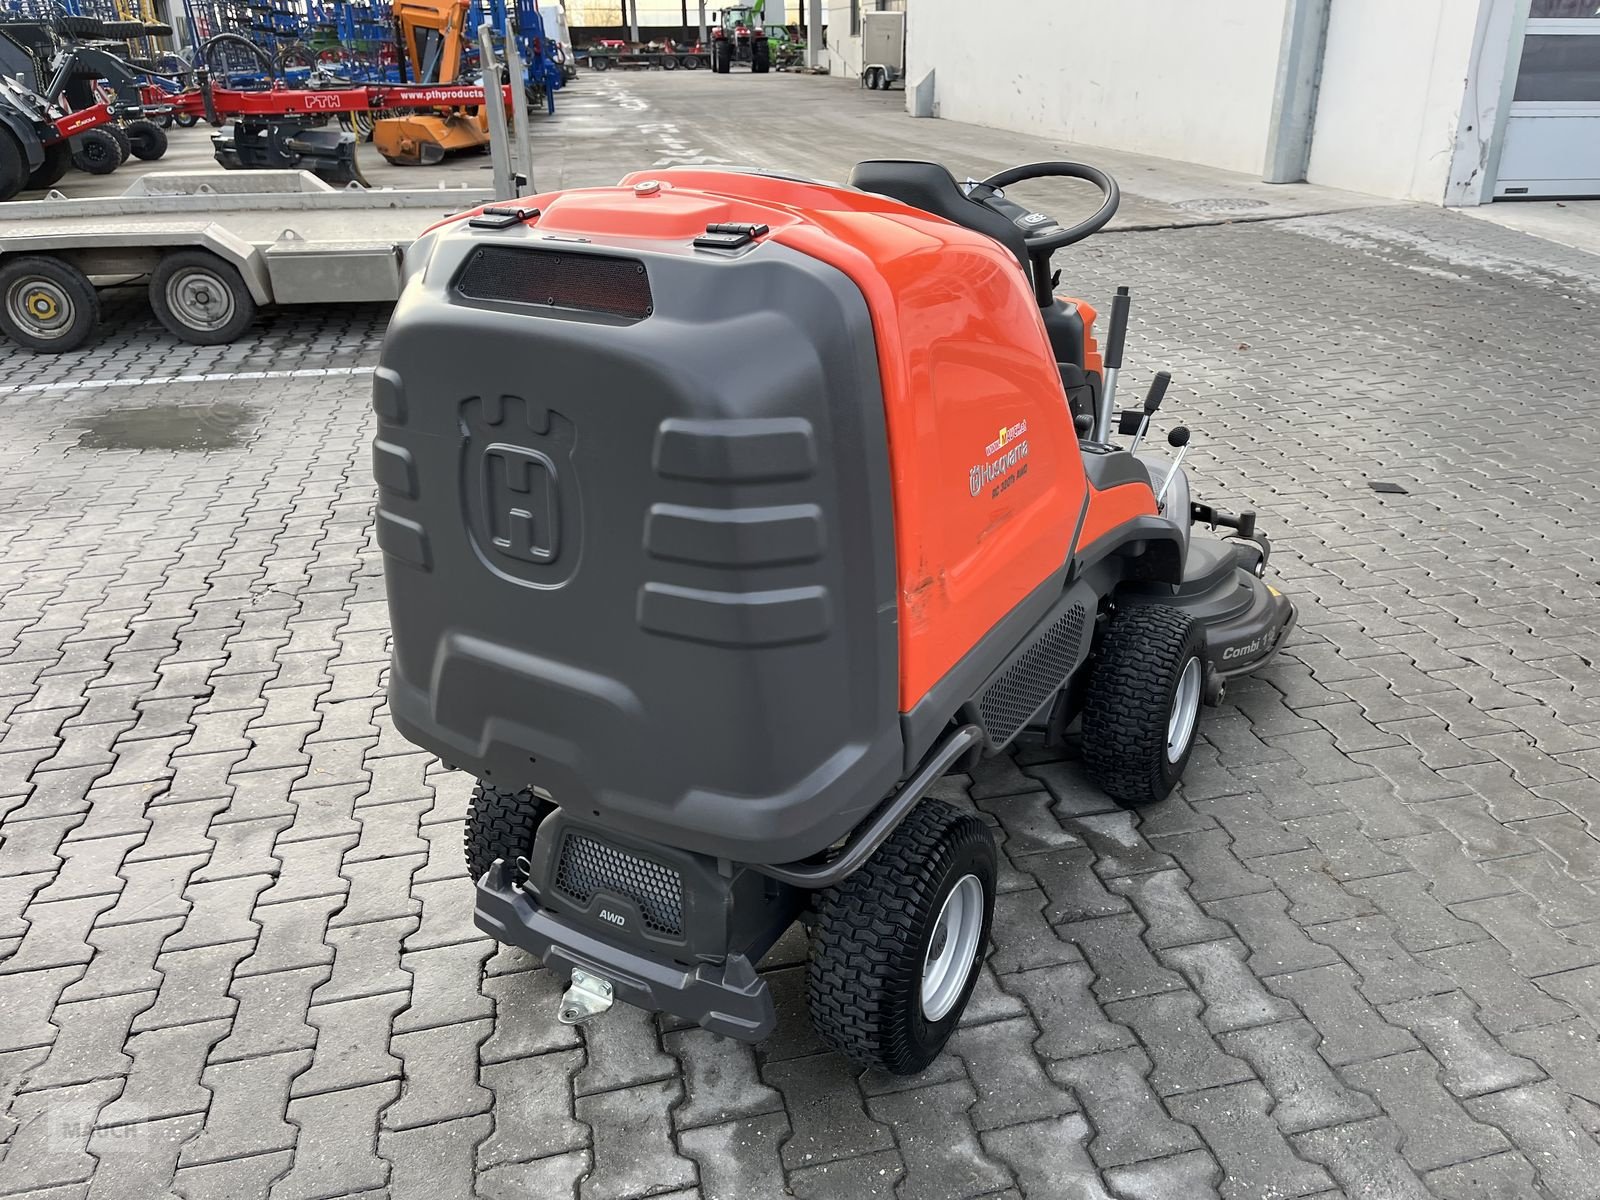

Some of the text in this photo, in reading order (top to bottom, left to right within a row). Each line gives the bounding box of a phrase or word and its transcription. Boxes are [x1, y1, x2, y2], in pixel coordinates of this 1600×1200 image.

[305, 95, 341, 109] PTH
[400, 90, 506, 101] www.pthproducts
[982, 440, 1028, 486] Husqvarna
[1223, 638, 1261, 660] Combi
[599, 909, 625, 926] AWD
